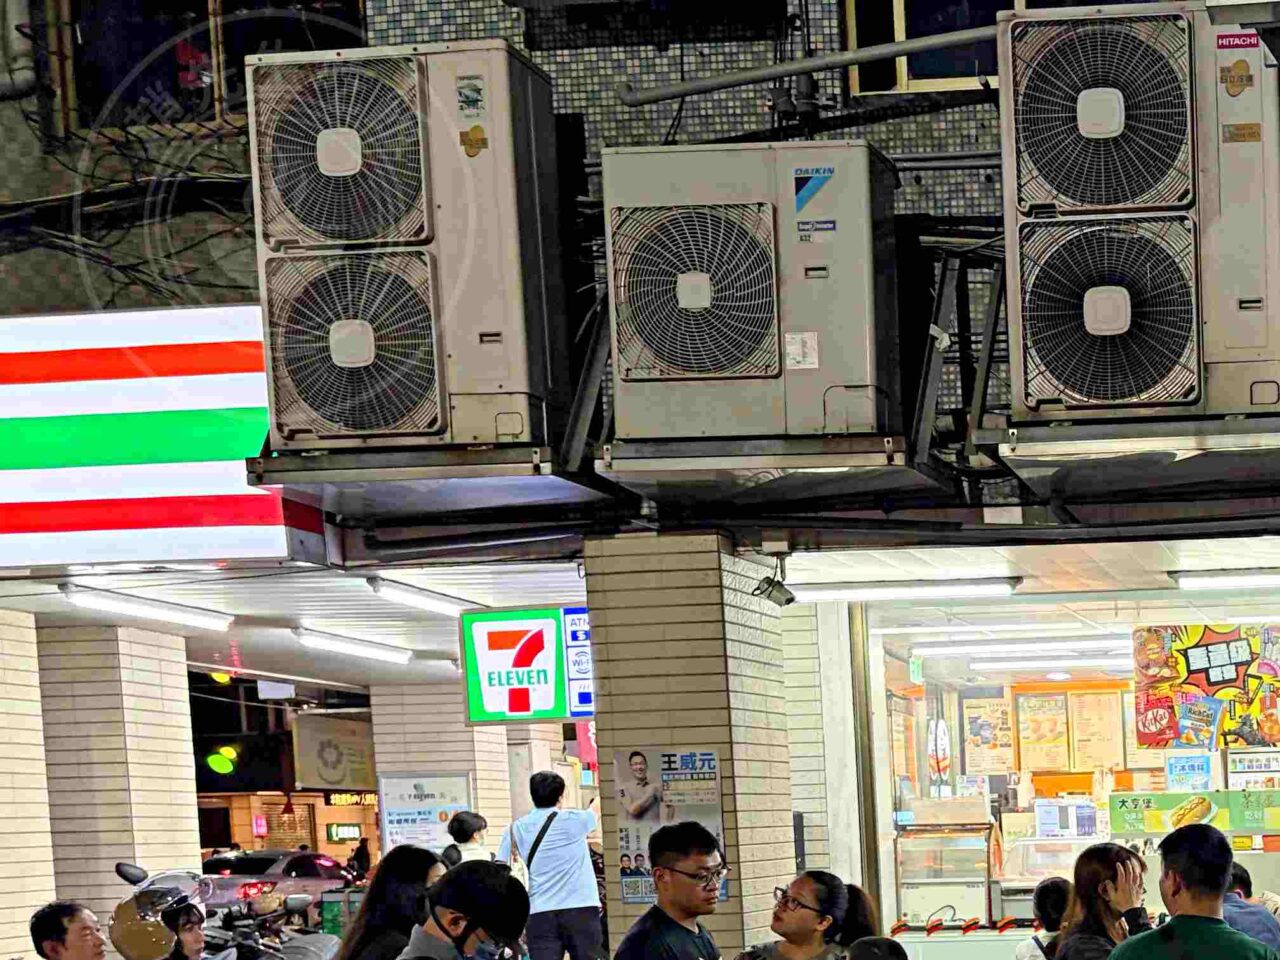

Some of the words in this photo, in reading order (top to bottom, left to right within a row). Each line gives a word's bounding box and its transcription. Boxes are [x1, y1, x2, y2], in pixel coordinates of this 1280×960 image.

[1218, 37, 1257, 46] HITACHI
[795, 167, 834, 175] DAIKIN
[487, 628, 545, 713] 7
[661, 752, 716, 771] 王威元
[1118, 797, 1153, 809] 大亨堡
